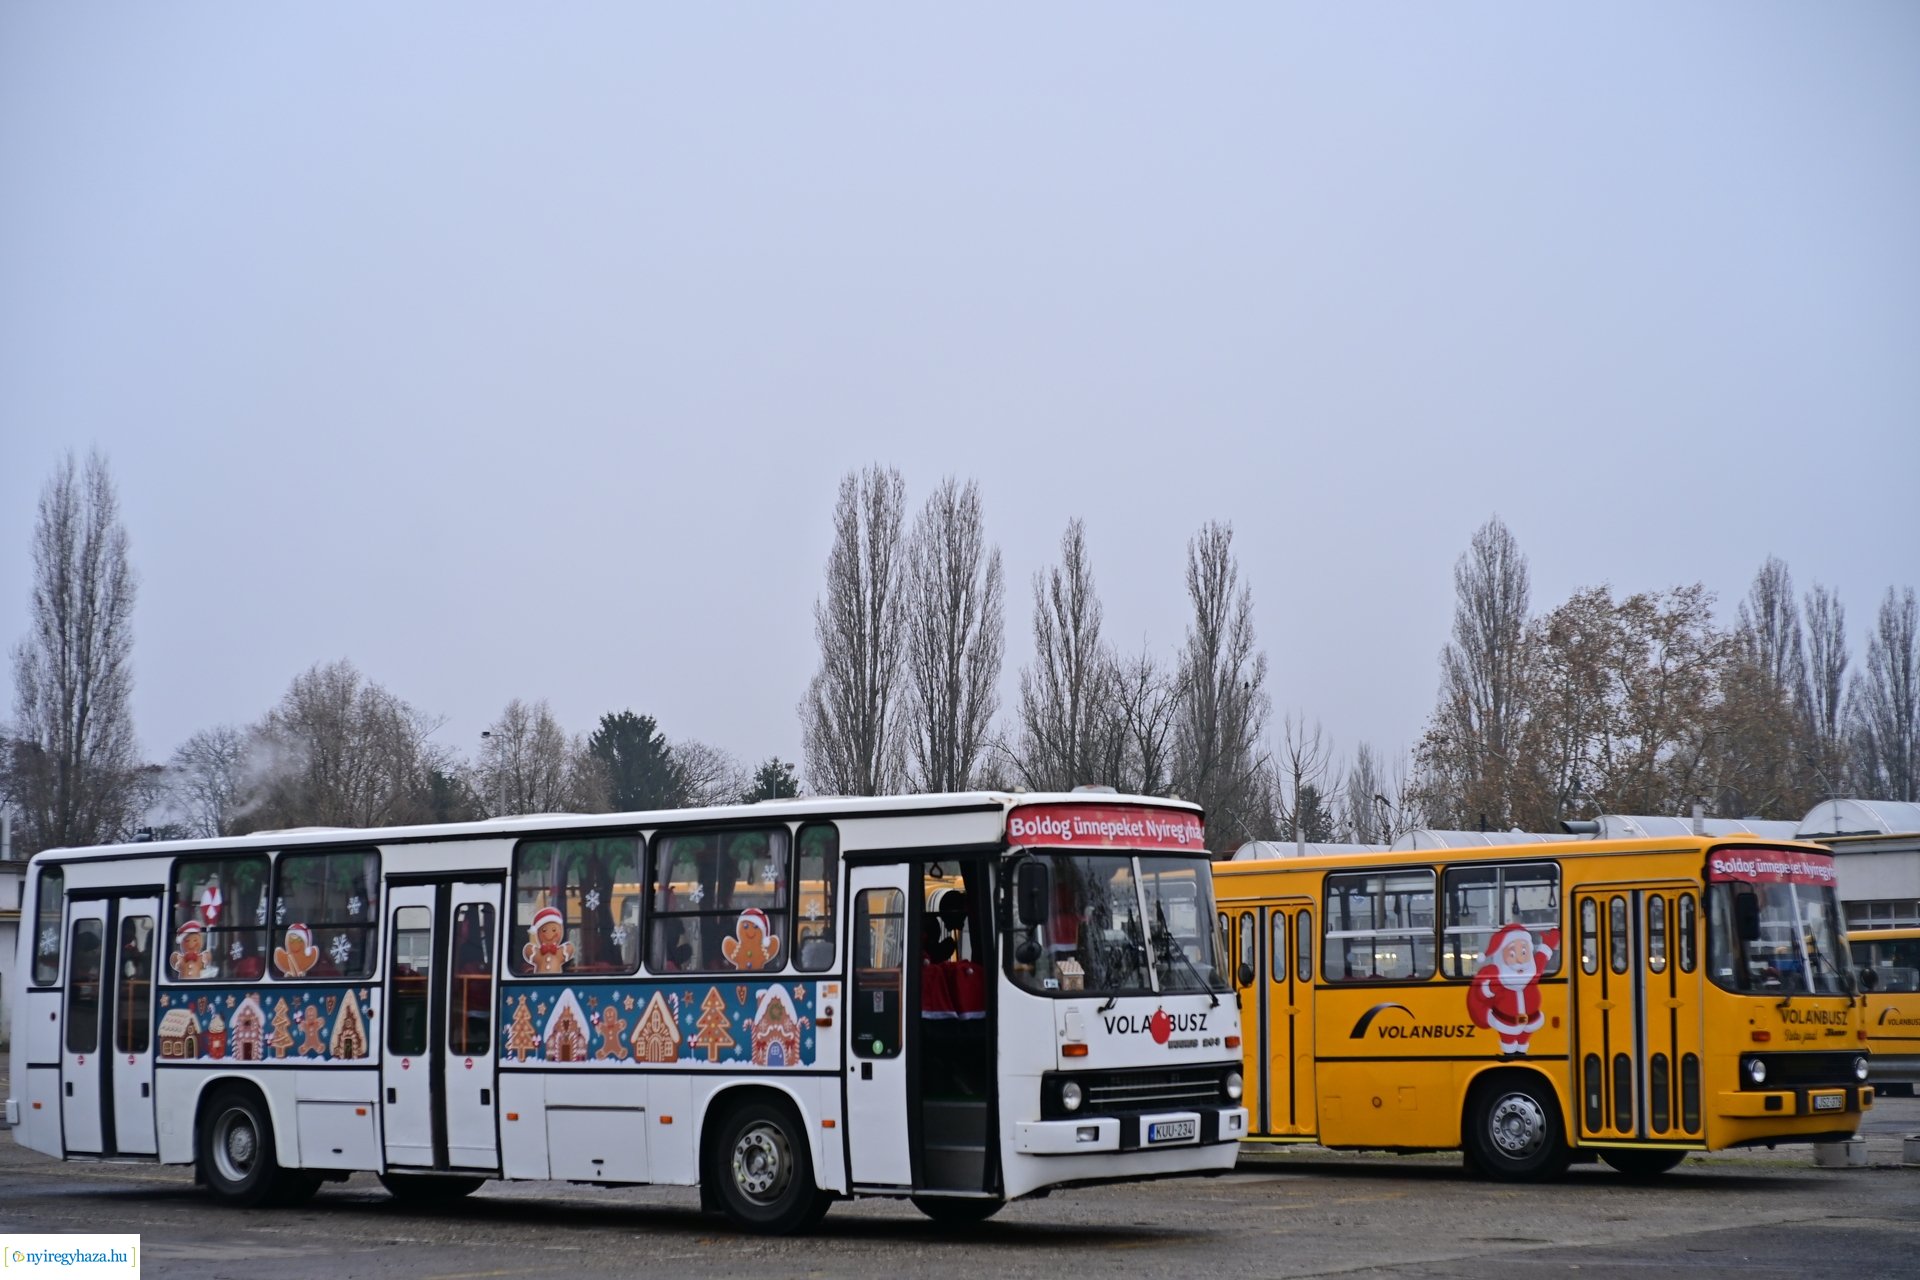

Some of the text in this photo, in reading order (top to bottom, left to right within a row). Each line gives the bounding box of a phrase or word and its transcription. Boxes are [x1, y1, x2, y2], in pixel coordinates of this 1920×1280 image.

[1011, 817, 1072, 840] Boldog
[1074, 816, 1143, 840] ünnepeket
[1156, 1123, 1192, 1138] KUU-234
